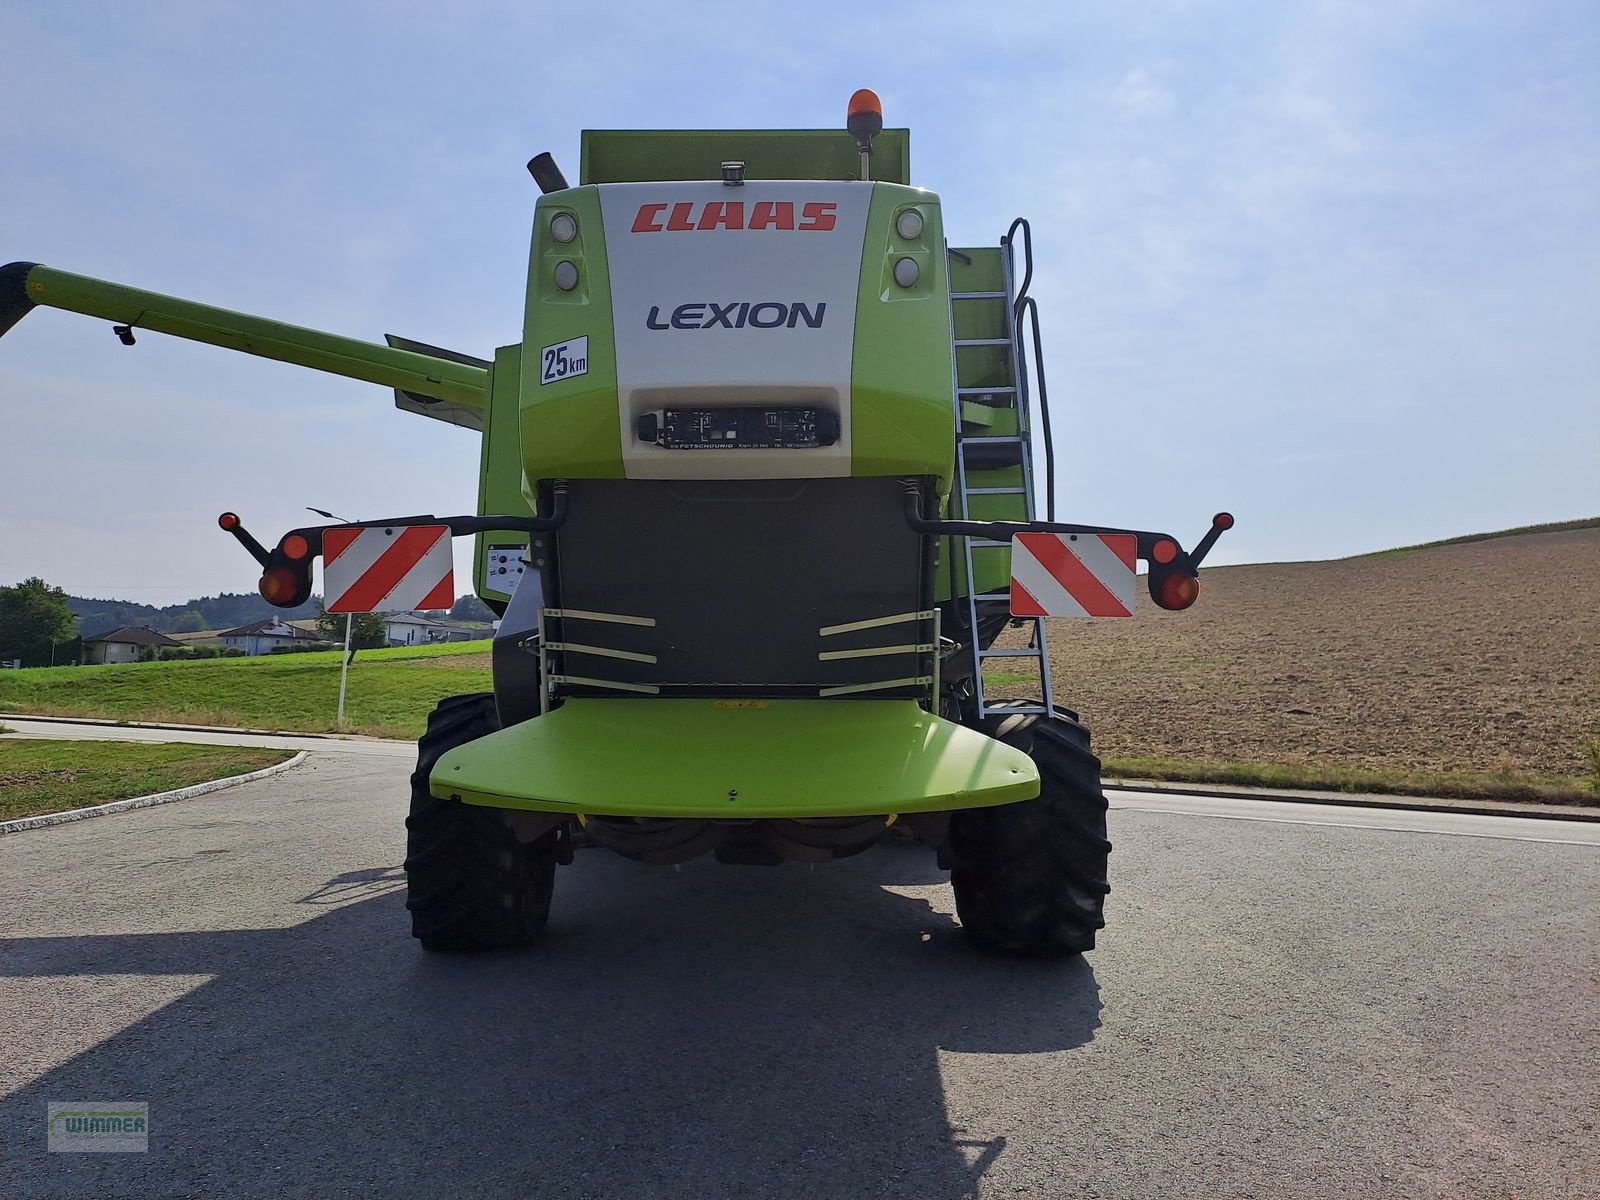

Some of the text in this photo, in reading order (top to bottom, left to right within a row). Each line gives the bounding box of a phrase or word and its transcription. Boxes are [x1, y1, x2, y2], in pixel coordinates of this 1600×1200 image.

[631, 202, 838, 233] CLAAS
[646, 303, 826, 330] LEXION
[544, 345, 586, 380] 25 km
